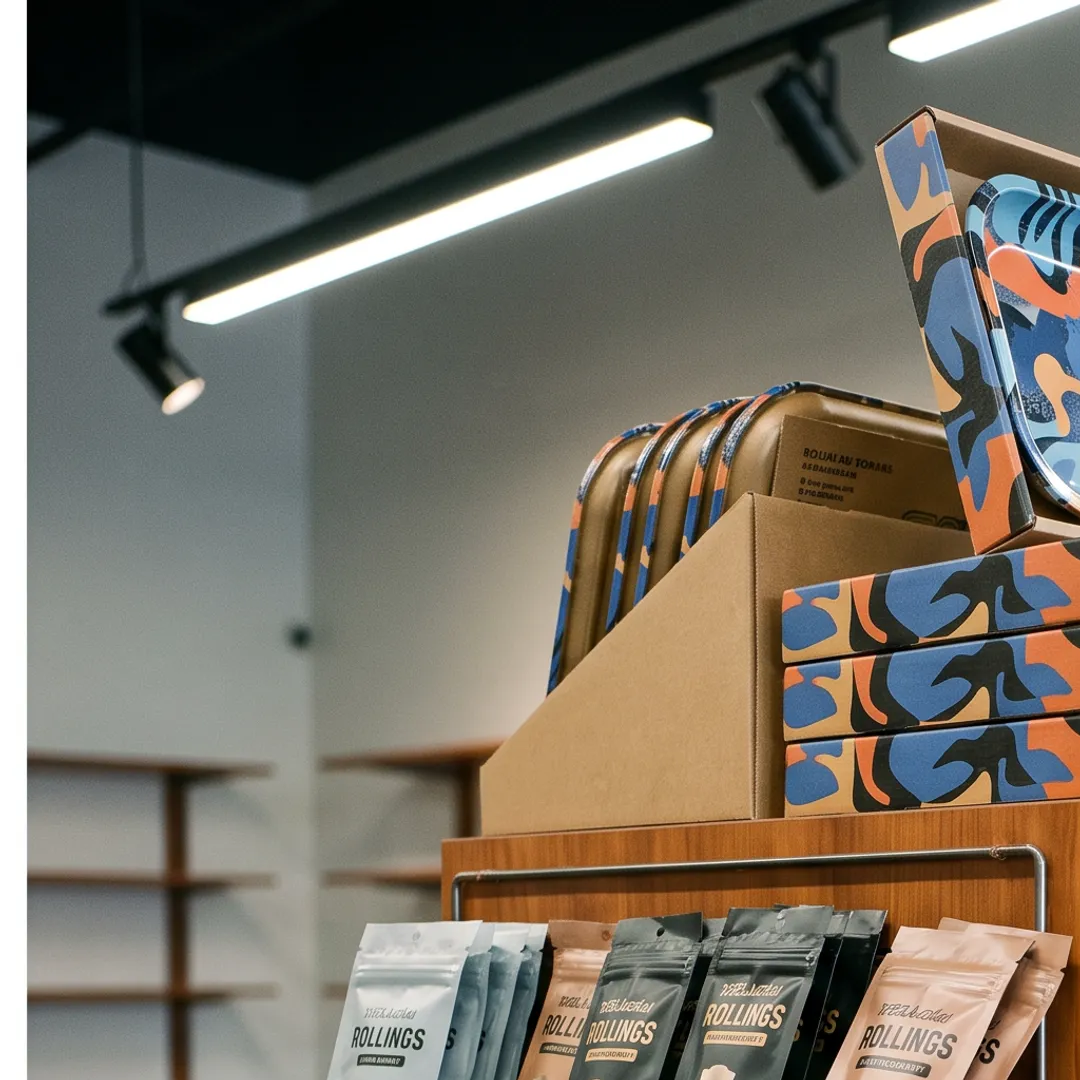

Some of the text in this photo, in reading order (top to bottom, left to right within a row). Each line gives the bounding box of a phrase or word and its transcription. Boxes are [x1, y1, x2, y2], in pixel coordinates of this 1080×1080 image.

[702, 1003, 786, 1030] ROLLINGS
[351, 1026, 426, 1050] ROLLINGS
[586, 1019, 657, 1045] ROLLINGS
[858, 1024, 957, 1060] ROLLINGS
